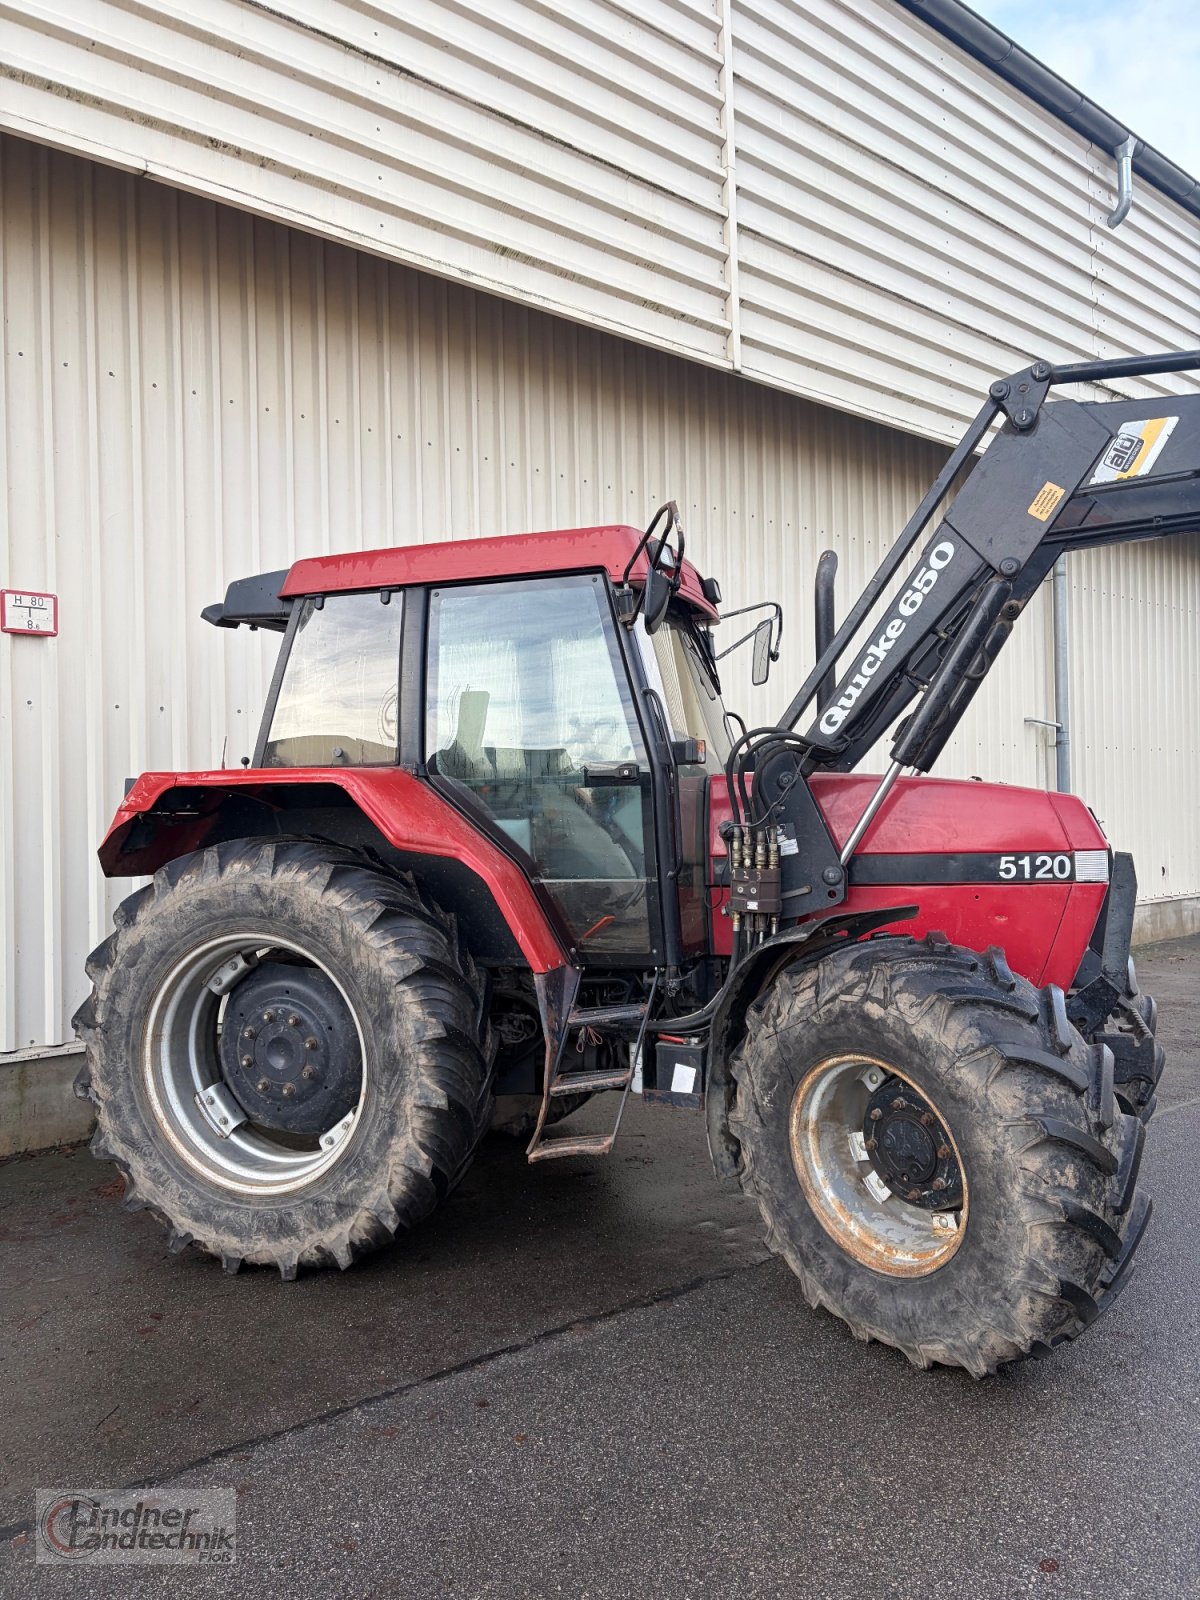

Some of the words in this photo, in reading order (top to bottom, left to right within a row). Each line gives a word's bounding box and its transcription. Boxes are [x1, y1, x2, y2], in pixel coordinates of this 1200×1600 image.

[14, 594, 22, 605] H
[30, 596, 44, 607] 80
[819, 618, 906, 735] Quicke
[898, 541, 955, 617] 650
[998, 855, 1071, 879] 5120
